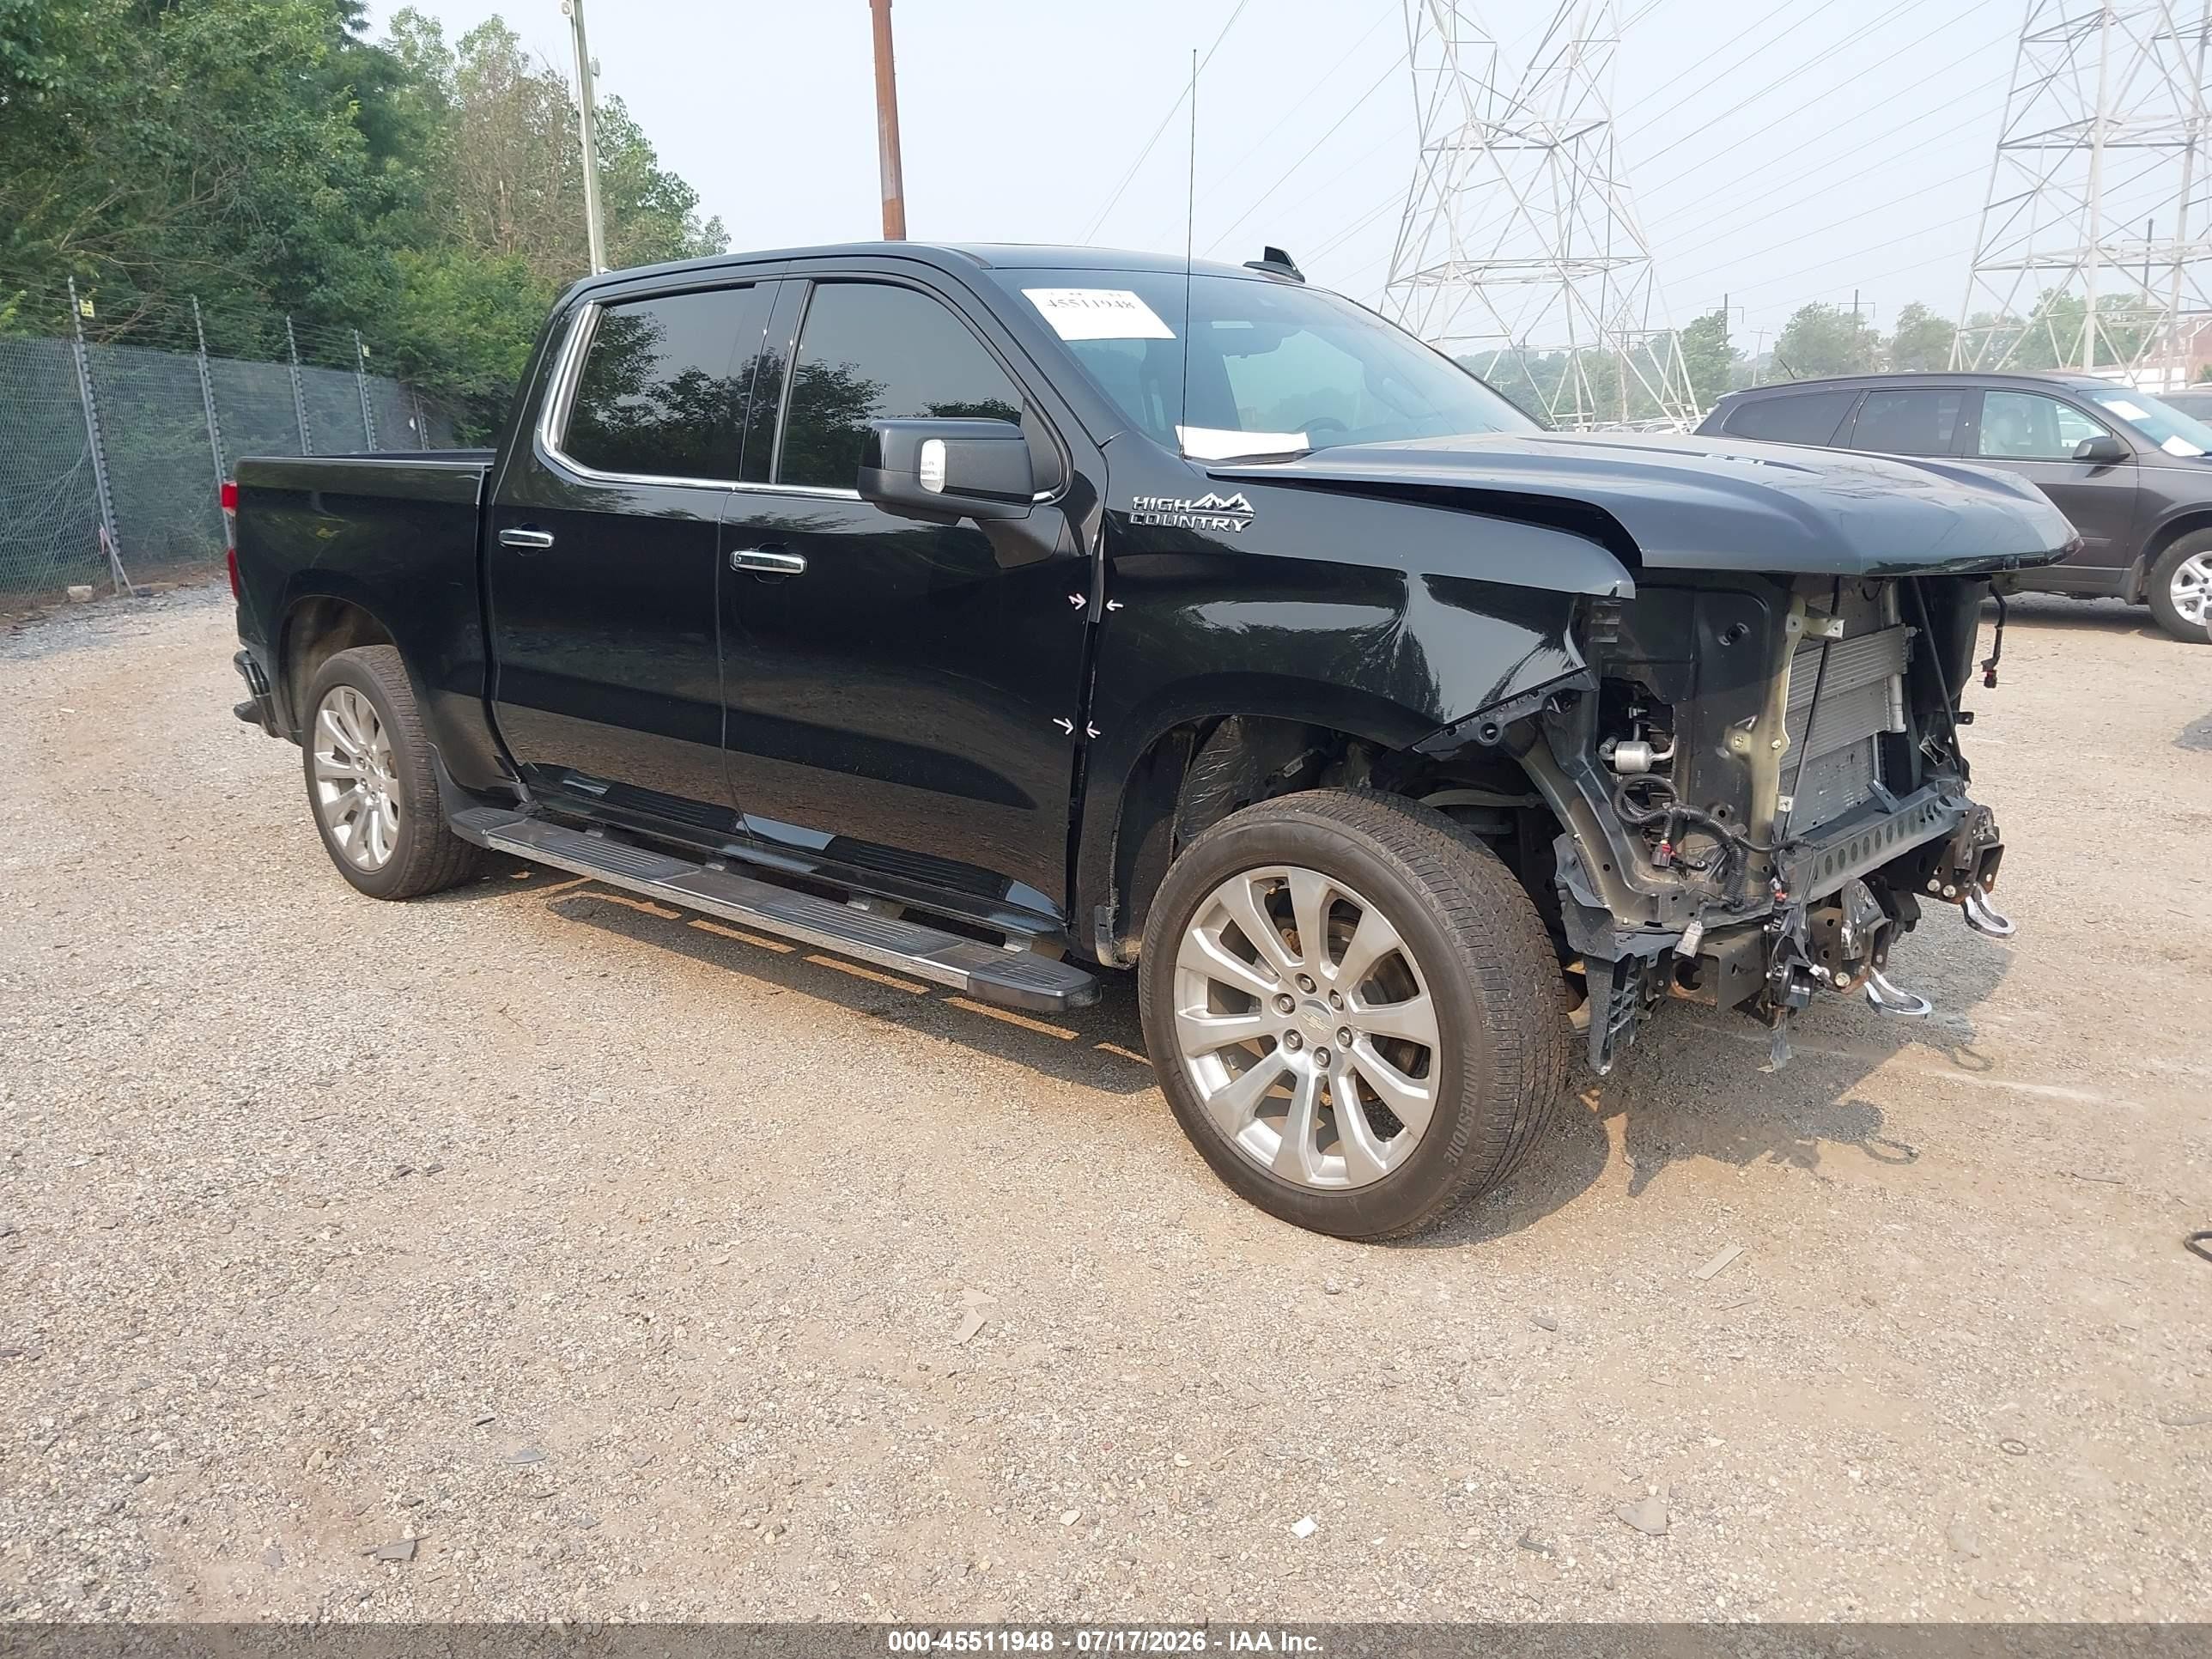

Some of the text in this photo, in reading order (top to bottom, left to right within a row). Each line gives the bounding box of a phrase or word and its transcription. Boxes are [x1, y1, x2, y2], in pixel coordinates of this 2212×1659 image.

[1132, 495, 1193, 513] HIGH
[1129, 512, 1253, 533] COUNTRY
[1443, 1042, 1479, 1167] BRIDGESTONE
